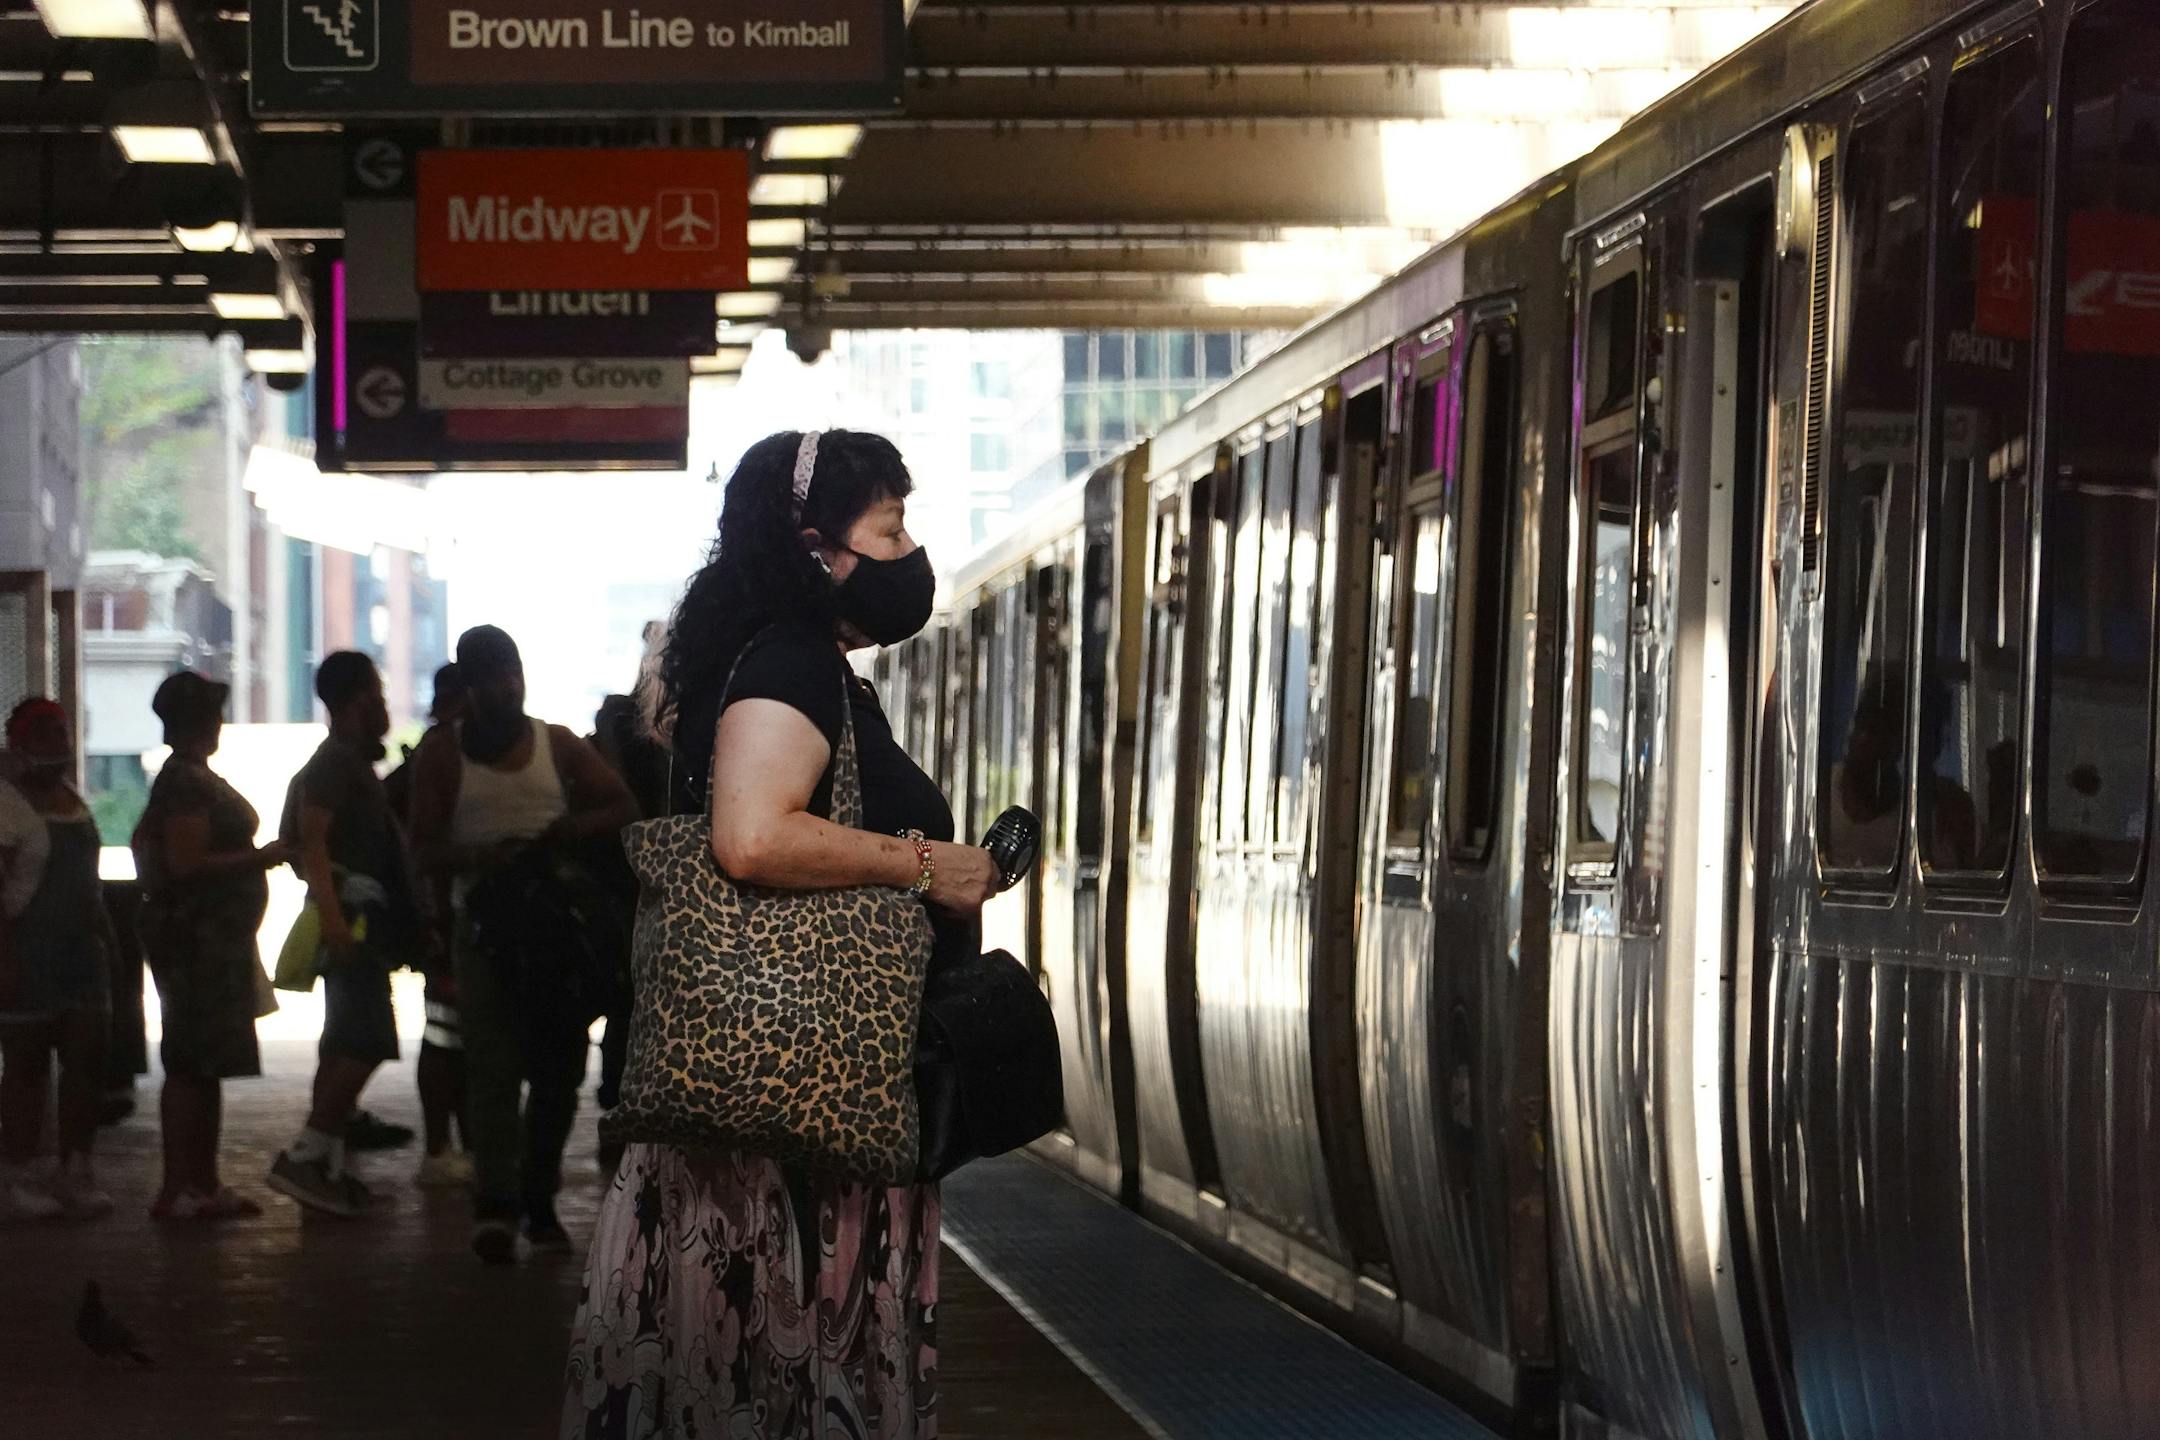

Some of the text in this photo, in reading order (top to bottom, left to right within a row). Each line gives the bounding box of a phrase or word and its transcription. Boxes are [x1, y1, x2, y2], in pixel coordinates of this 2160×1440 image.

[449, 10, 851, 49] Brown Line to Kimball
[448, 195, 650, 254] Midway
[444, 360, 662, 395] Cottage Grove
